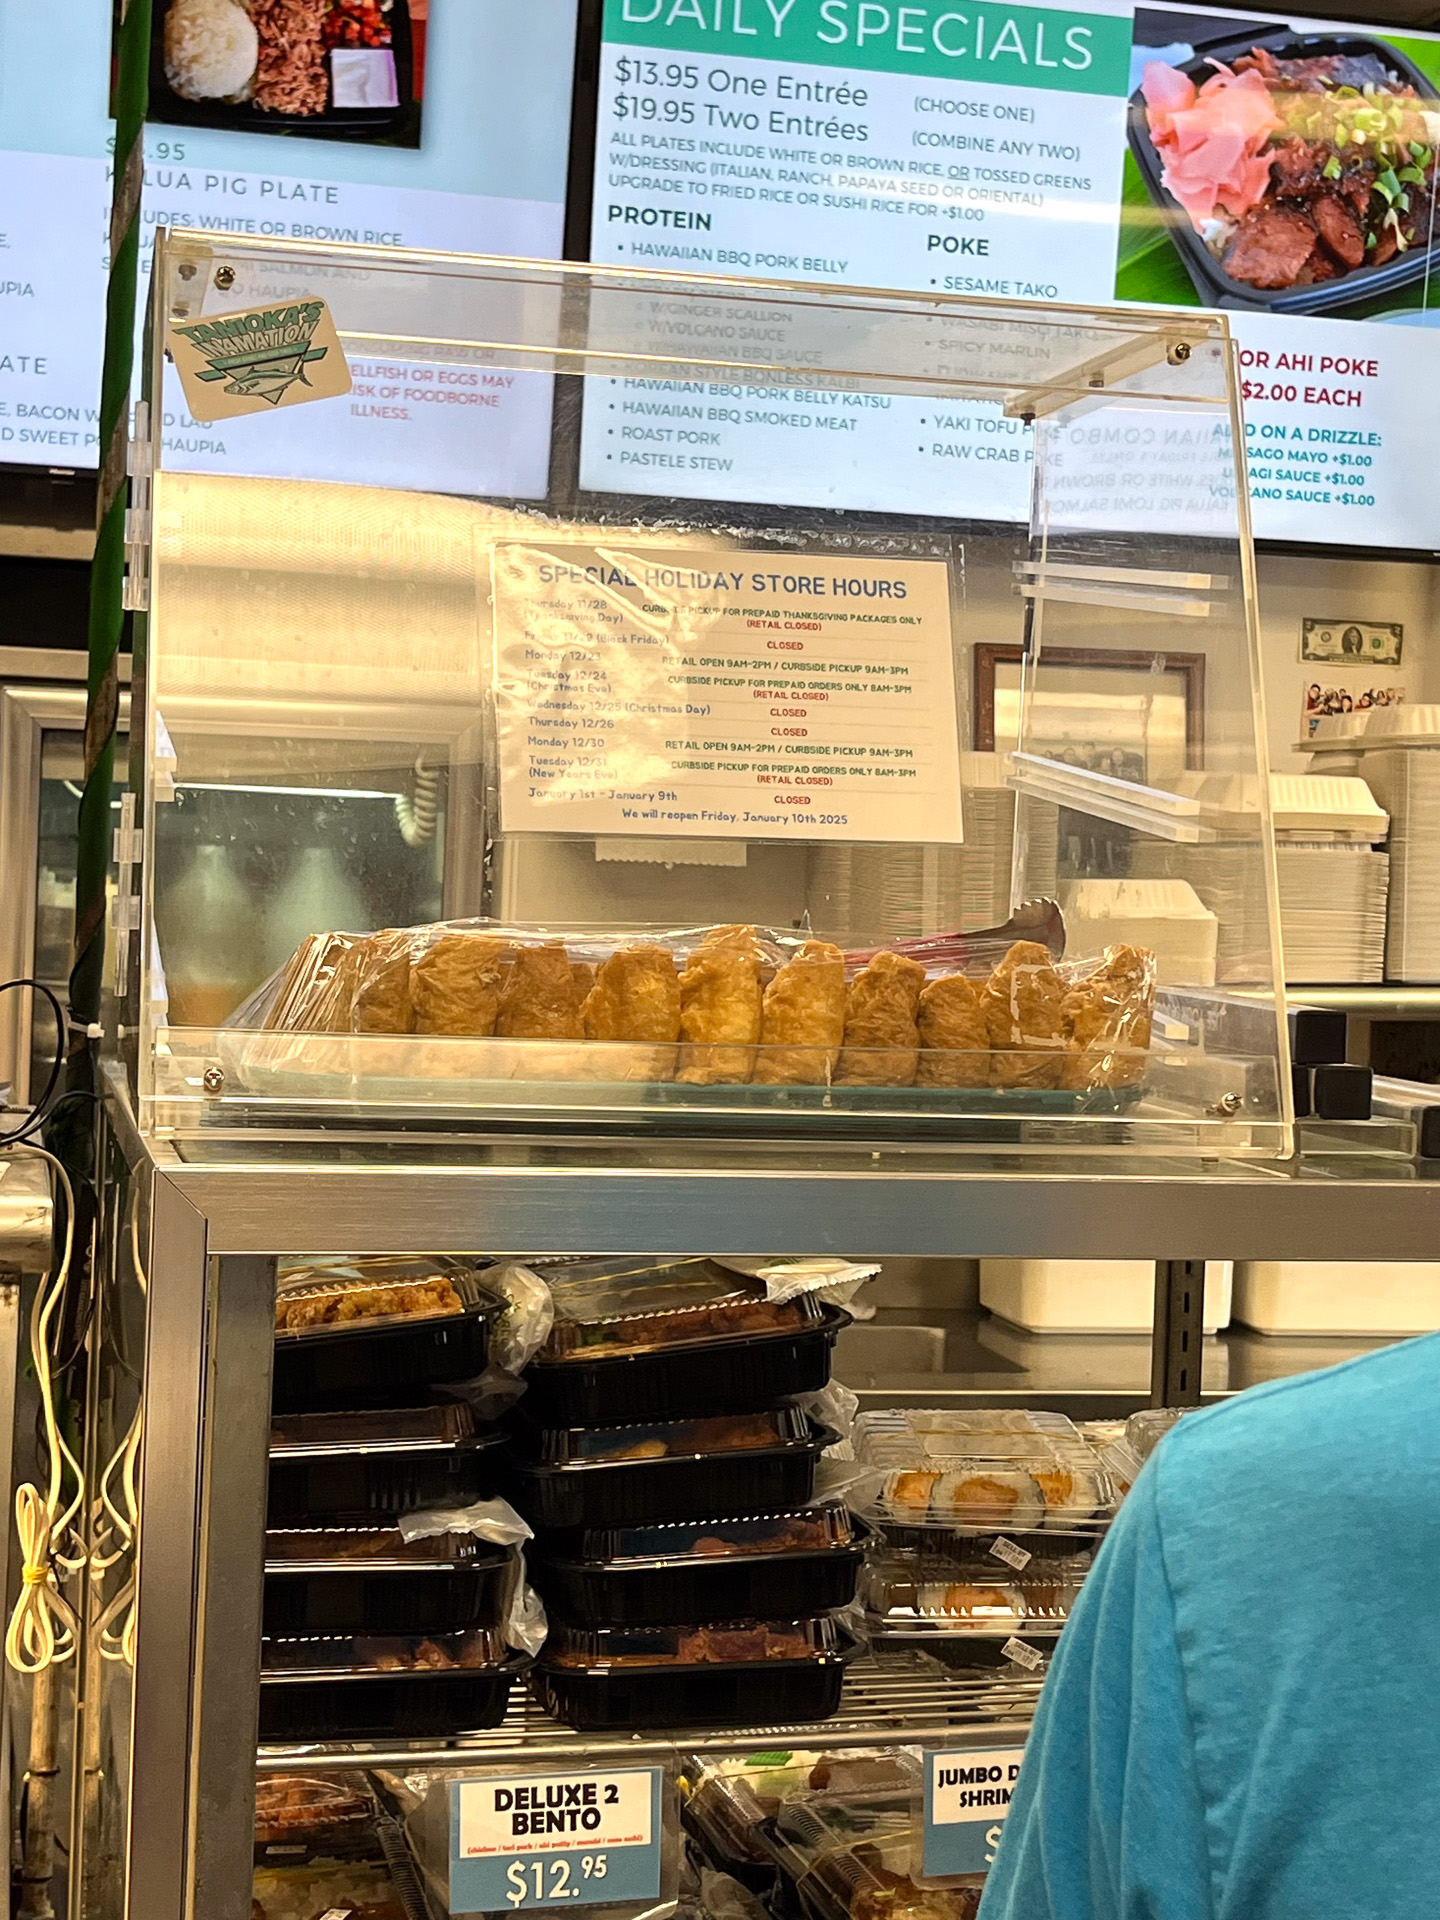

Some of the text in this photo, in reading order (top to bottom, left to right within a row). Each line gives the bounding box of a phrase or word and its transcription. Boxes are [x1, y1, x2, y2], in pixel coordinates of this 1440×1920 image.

[816, 0, 1093, 70] SPECIALS
[615, 56, 868, 106] $13.95 One Entrée
[613, 92, 868, 142] $19.95 Two Entrées
[914, 96, 1035, 123] (CHOOSE ONE)
[912, 131, 1080, 162] (COMBINE ANY TWO)
[610, 132, 1091, 190] ALL PLATES INCLUDE WHITE OR BROWN OR TOSSED GREENS
[205, 175, 338, 204] PIG PLATE
[609, 153, 706, 174] W/DRESSING
[838, 175, 897, 192] PAPAYA
[901, 181, 939, 196] SEED
[942, 185, 964, 198] OR
[968, 187, 1044, 207] ORIENTAL)
[608, 174, 985, 222] UPGRADE TO FRIED RICE OR SUSHI RICE FOR +$1.00
[608, 205, 712, 231] PROTEIN
[199, 215, 358, 242] WHITE OR BROWN
[927, 234, 989, 256] POKE
[631, 242, 848, 273] HAWAIIAN BBQ PORK BELLY
[944, 276, 1058, 298] SESAME TAKO
[172, 301, 325, 343] TANIOKA'S
[1239, 350, 1378, 377] OR AHI POKE
[351, 364, 515, 389] ELLFISH OR EGGS MAY
[379, 386, 499, 407] OF FOODBORNE
[624, 377, 891, 409] HAWAIIAN BBQ PORK BELLY KATSU
[1242, 380, 1362, 407] $2.00 EACH
[16, 404, 79, 421] BACON
[351, 403, 412, 420] ILLNESS.
[623, 401, 857, 431] HAWAIIAN BBQ SMOKED MEAT
[934, 415, 1018, 435] YAKI TOFU
[19, 429, 79, 446] SWEET
[622, 426, 720, 446] ROAST PORK
[1261, 425, 1382, 446] ON A DRIZZLE:
[620, 451, 733, 471] PASTELE STEW
[932, 443, 1019, 462] RAW CRAB
[1288, 450, 1372, 467] MAYO +$1.00
[1275, 469, 1365, 486] SAUCE +$1.00
[1286, 489, 1375, 506] SAUCE +$1.00
[539, 565, 907, 599] SPECIAL HOLIDAY STORE HOURS
[742, 609, 922, 625] PREPAID THANKSGIVING PACKAGES ONLY
[747, 620, 822, 631] (RETAIL CLOSED)
[767, 641, 804, 650] CLOSED
[700, 658, 909, 675] OPEN 9AM-2PM CURBSIDE PICKUP 9AM-3PM
[713, 677, 911, 694] PICKUP PREPAID ORDERS ONLY 8AM-3PM
[753, 690, 829, 701] (RETAIL CLOSED)
[686, 704, 710, 716] Day)
[770, 708, 807, 717] CLOSED
[529, 717, 615, 729] Thursday 12/26
[771, 727, 808, 737] CLOSED
[528, 736, 568, 749] Monday
[665, 741, 913, 758] RETAIL OPEN 9AM-2PM CURBSIDE PICKUP 9AM-3PM
[671, 761, 916, 777] CURBSIDE PICKUP FOR PREPAID ORDERS ONLY 8AM-3PM
[757, 775, 833, 786] (RETAIL CLOSED)
[608, 789, 677, 802] January 9th
[774, 795, 811, 805] CLOSED
[622, 808, 848, 825] We reopen January 10th 2025
[938, 1766, 1002, 1789] JUMBO
[494, 1783, 619, 1812] DELUXE 2
[960, 1788, 1014, 1808] SHRIM
[512, 1807, 601, 1835] BENTO
